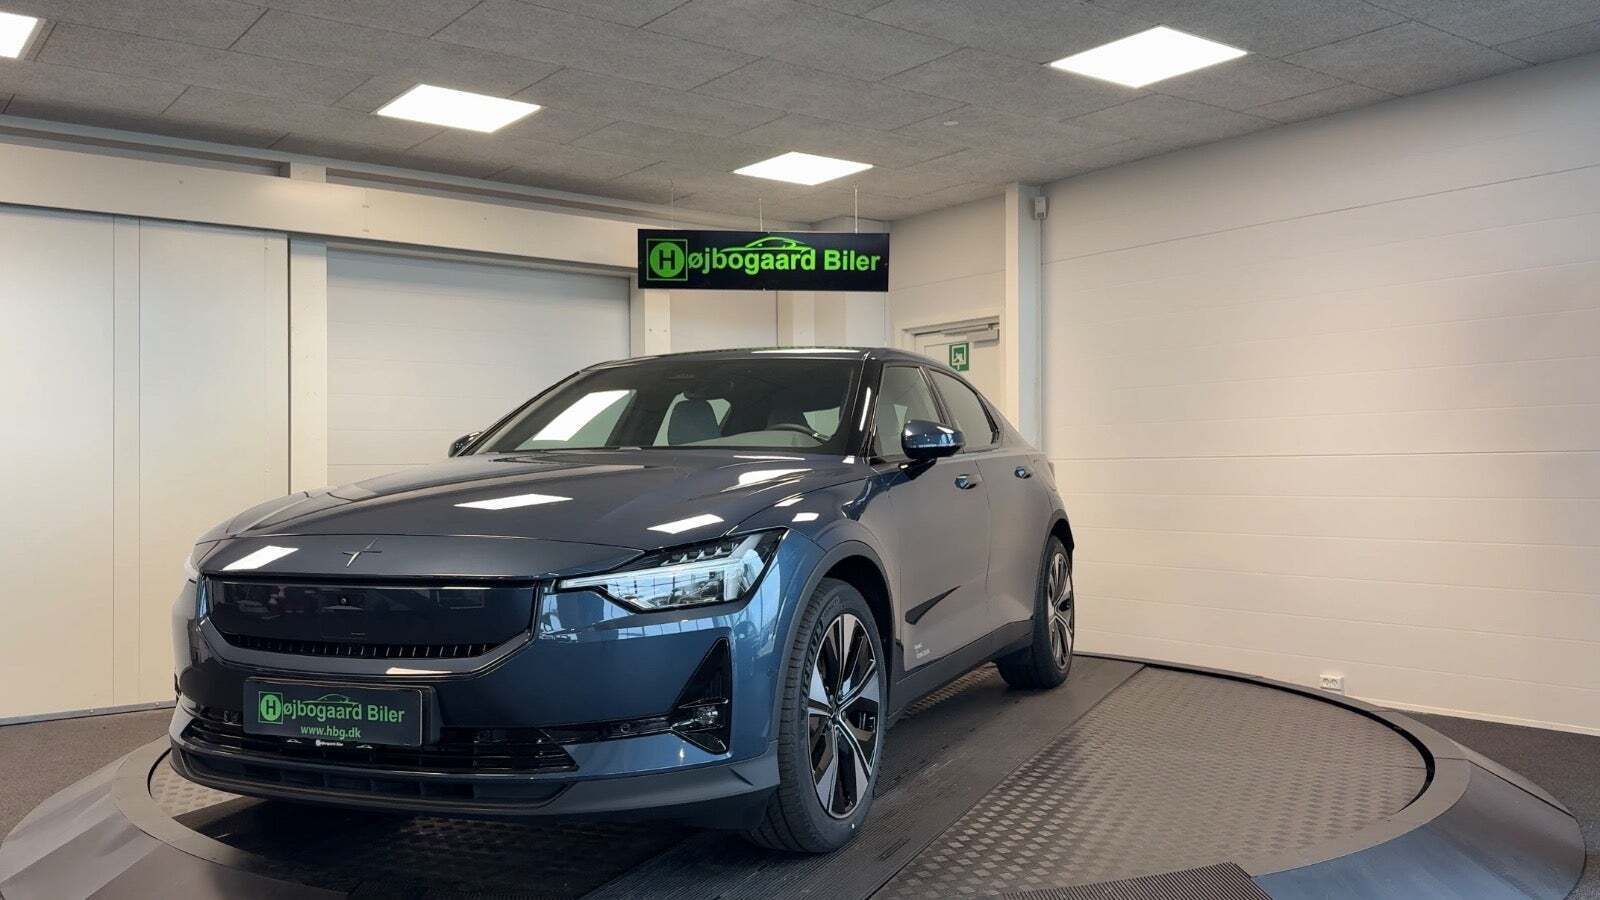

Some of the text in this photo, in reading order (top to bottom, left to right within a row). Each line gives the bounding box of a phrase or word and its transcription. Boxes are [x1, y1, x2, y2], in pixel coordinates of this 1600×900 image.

[650, 243, 881, 276] Højbogaard Biler
[260, 694, 405, 723] Højbogaard Biler
[300, 725, 362, 740] www.hbg.dk
